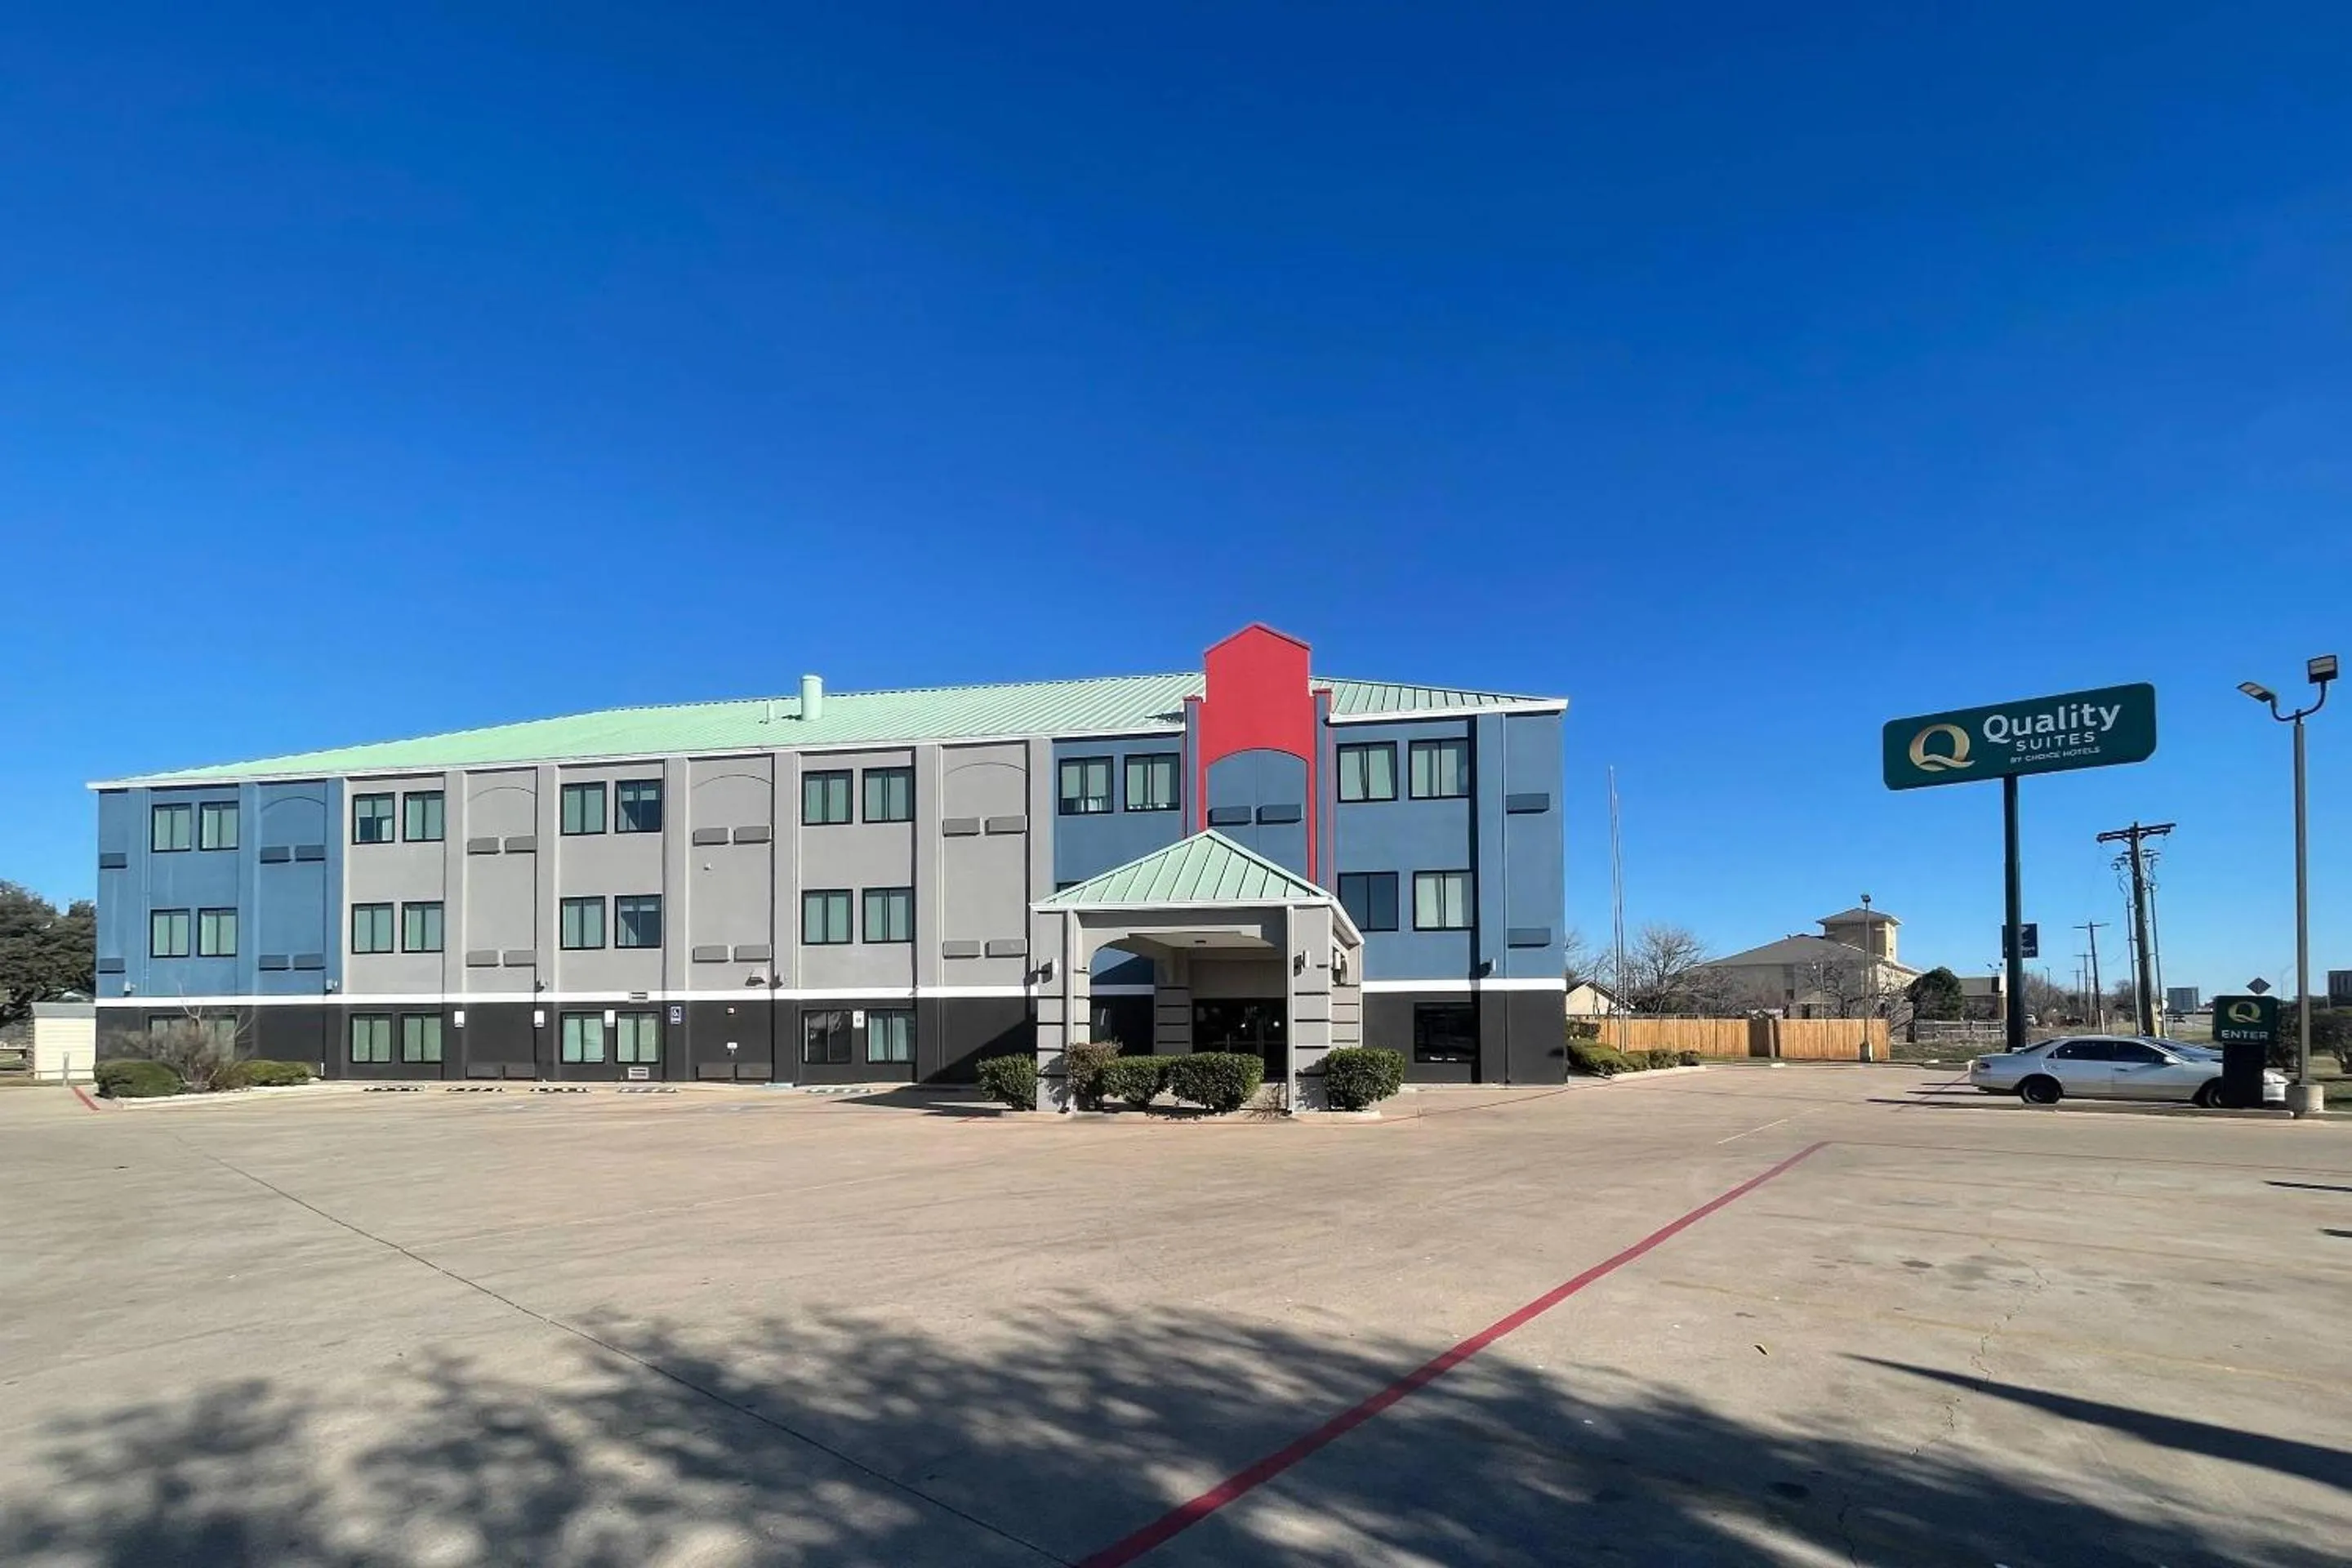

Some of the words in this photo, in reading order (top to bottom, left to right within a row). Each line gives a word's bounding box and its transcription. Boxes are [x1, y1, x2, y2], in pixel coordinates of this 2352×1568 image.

[1983, 703, 2122, 744] Quality
[1909, 723, 1976, 772] Q
[2016, 732, 2096, 752] SUITES
[2010, 756, 2022, 764] BY
[2025, 751, 2060, 762] CHOICE
[2063, 746, 2101, 757] HOTELS
[2228, 1000, 2262, 1023] Q
[2221, 1030, 2270, 1040] ENTER
